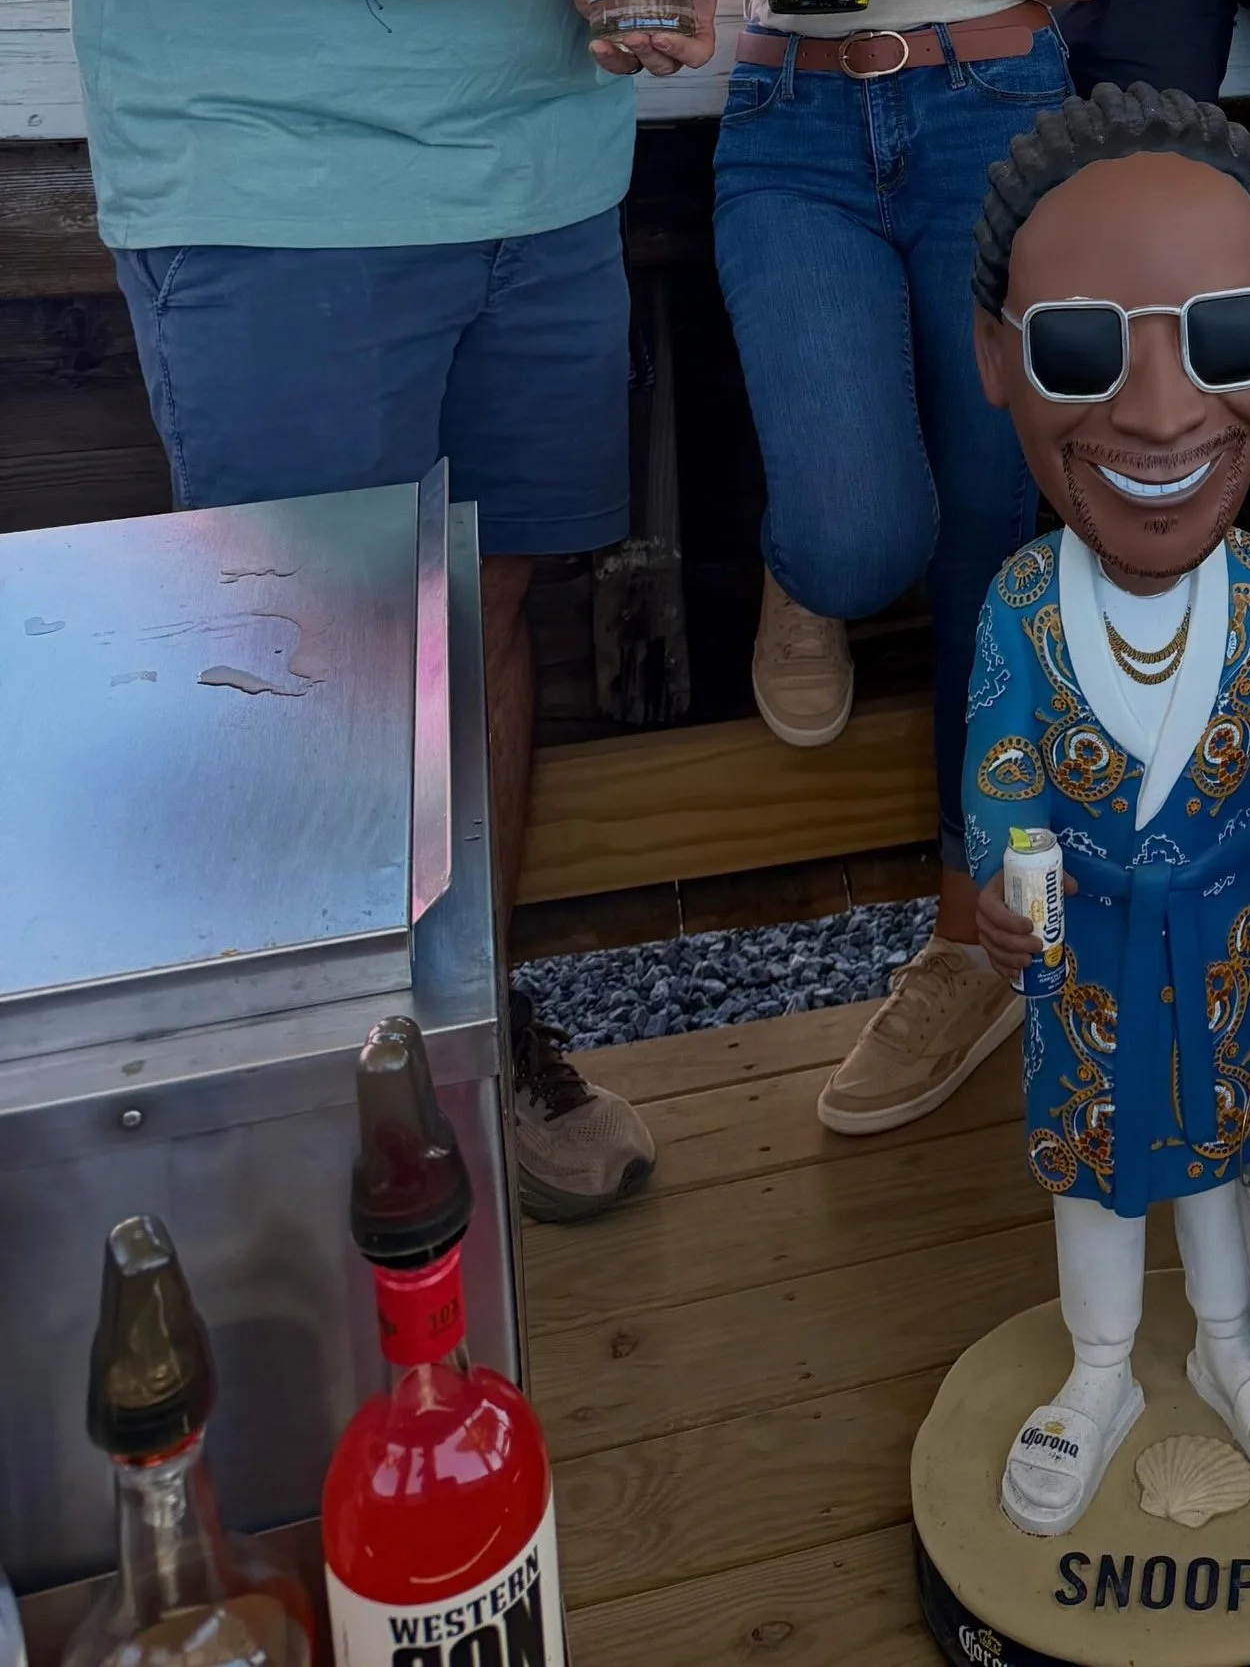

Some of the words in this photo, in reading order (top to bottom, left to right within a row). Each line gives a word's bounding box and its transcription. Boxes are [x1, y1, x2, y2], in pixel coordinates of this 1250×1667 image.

[1043, 870, 1062, 944] Corona
[1020, 1427, 1080, 1460] Corona
[389, 1543, 541, 1646] WESTERN
